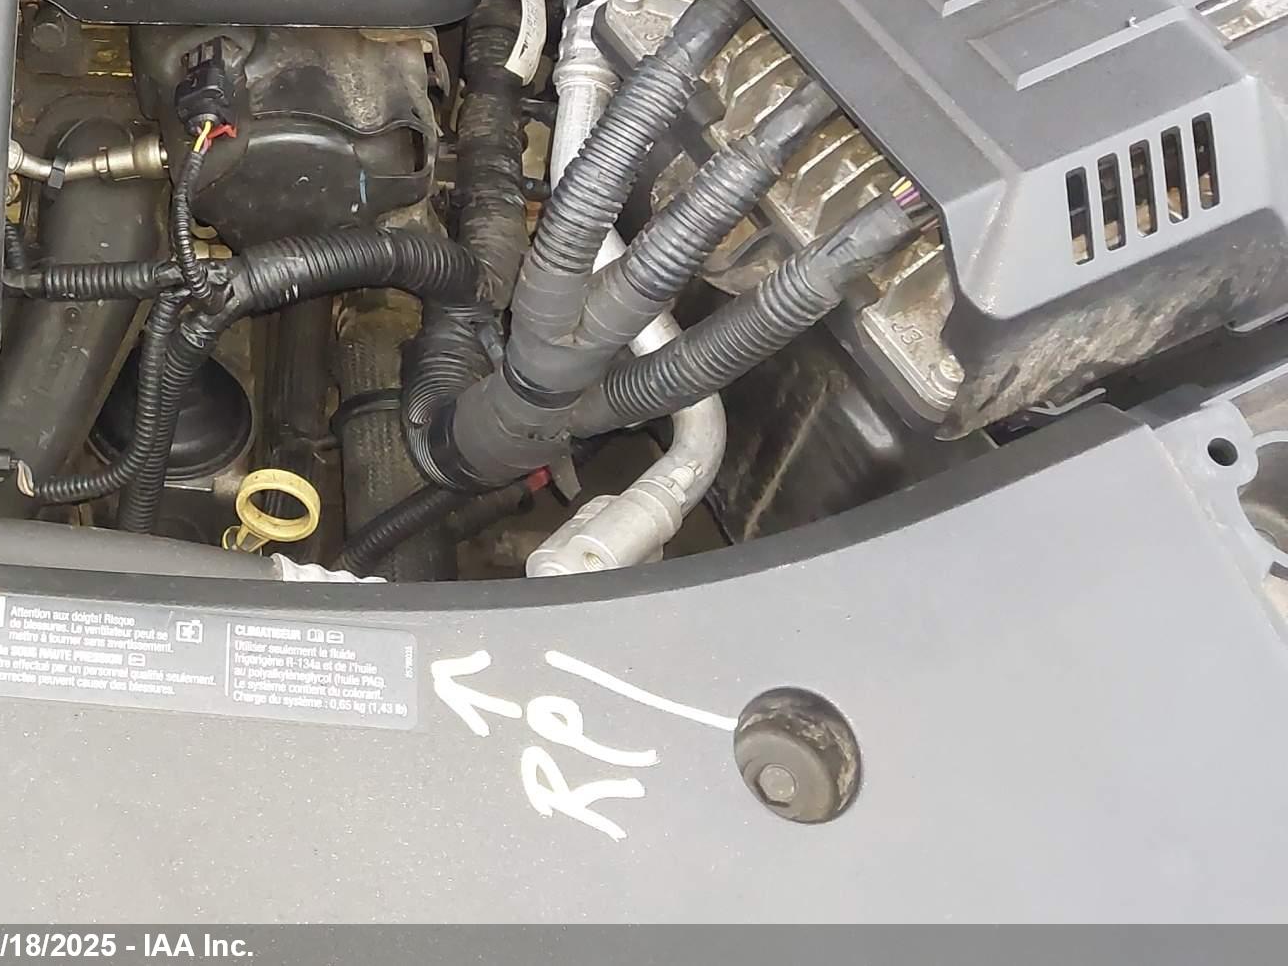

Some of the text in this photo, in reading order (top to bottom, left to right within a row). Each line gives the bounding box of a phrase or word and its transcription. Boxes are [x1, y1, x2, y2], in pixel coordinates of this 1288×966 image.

[11, 607, 50, 619] Attention
[52, 611, 68, 620] aux
[104, 614, 134, 627] Risque
[9, 618, 20, 628] de
[71, 623, 81, 633] Le
[134, 628, 154, 641] peut
[156, 631, 167, 640] se
[51, 663, 67, 674] par
[69, 665, 80, 674] un
[234, 668, 245, 676] au
[286, 657, 320, 669] R-134a
[322, 661, 332, 670] et
[334, 661, 346, 672] de
[76, 678, 107, 689] causer
[234, 678, 245, 688] Le
[327, 686, 340, 696] du
[233, 690, 265, 705] Charge
[268, 693, 280, 704] du
[329, 699, 351, 711] 0,65
[353, 700, 365, 713] kg
[368, 701, 391, 715] (1,43
